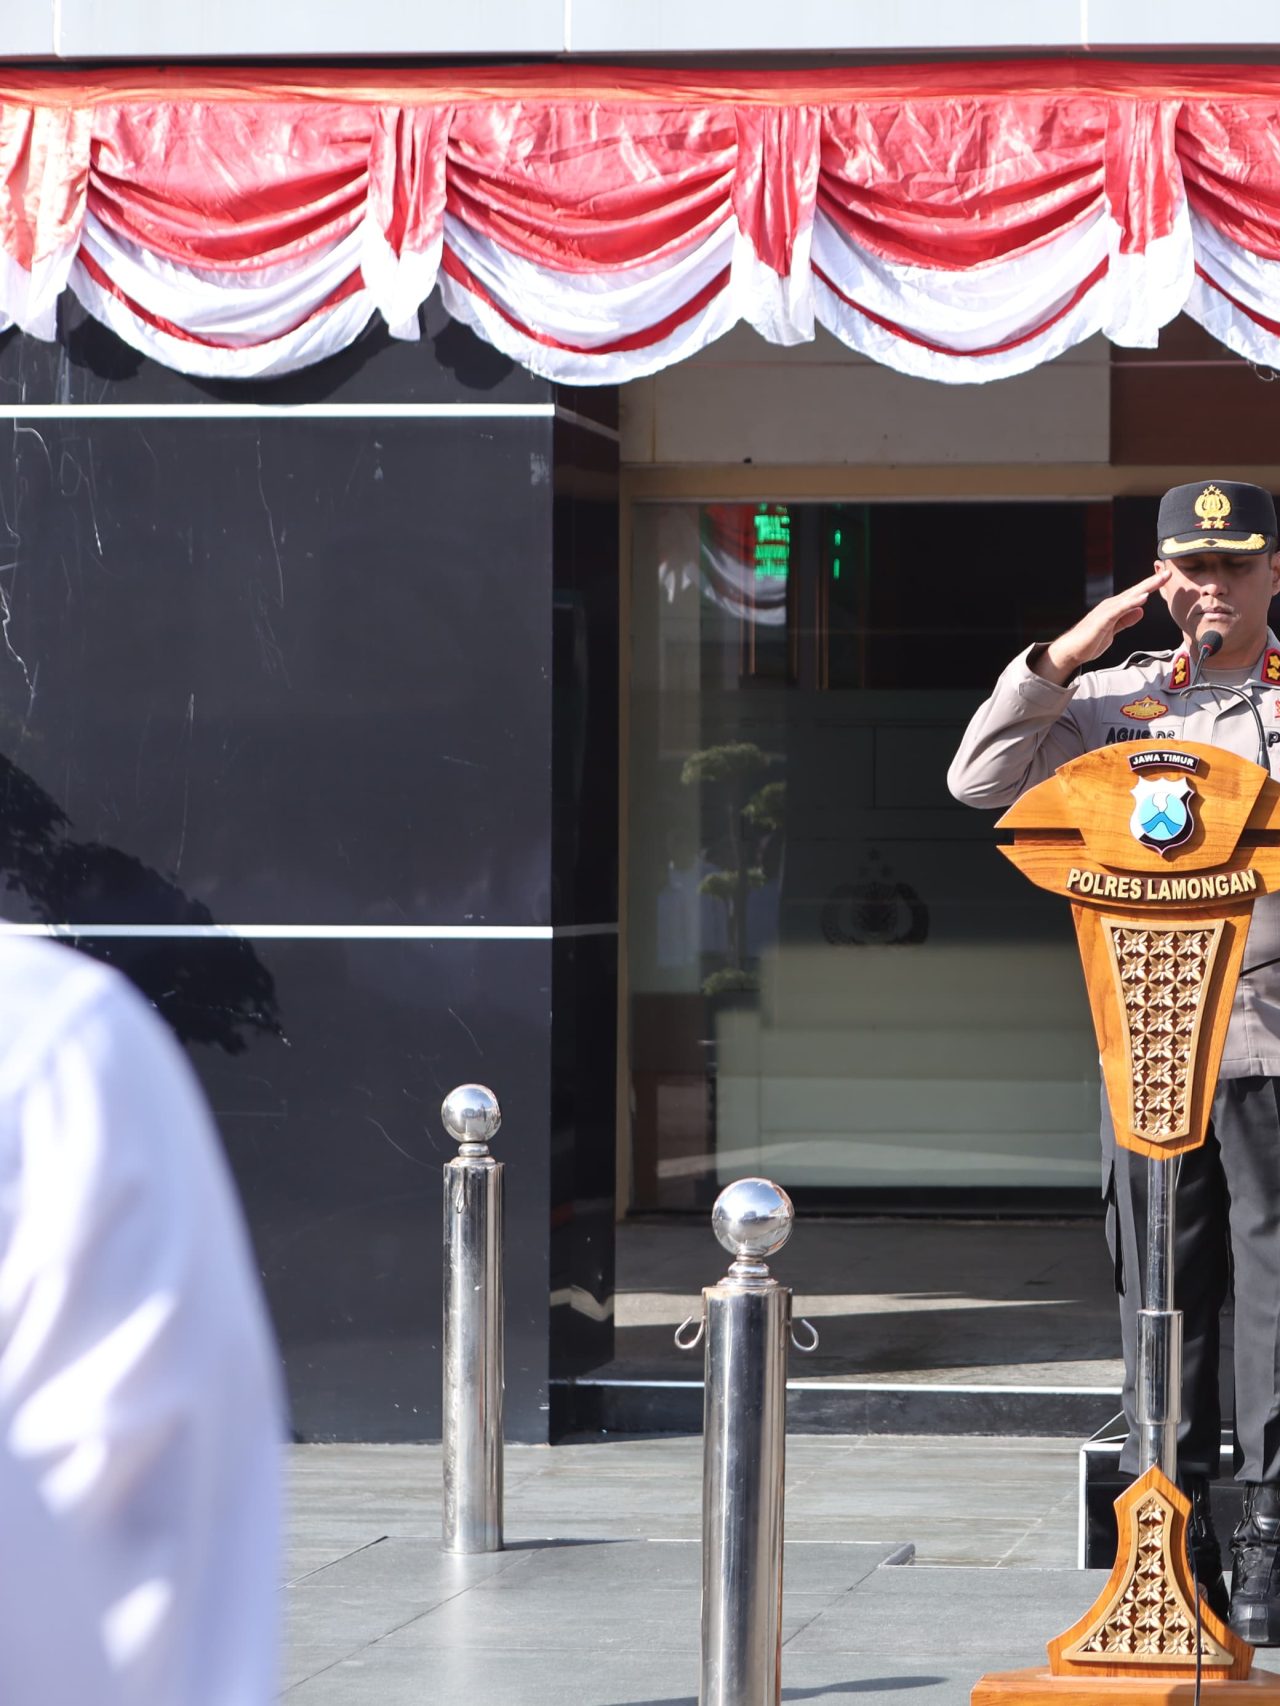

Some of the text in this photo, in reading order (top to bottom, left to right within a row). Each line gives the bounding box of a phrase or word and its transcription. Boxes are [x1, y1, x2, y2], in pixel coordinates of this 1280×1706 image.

[1132, 753, 1194, 767] JAWA TIMUR
[1066, 868, 1257, 901] POLRES LAMONGAN
